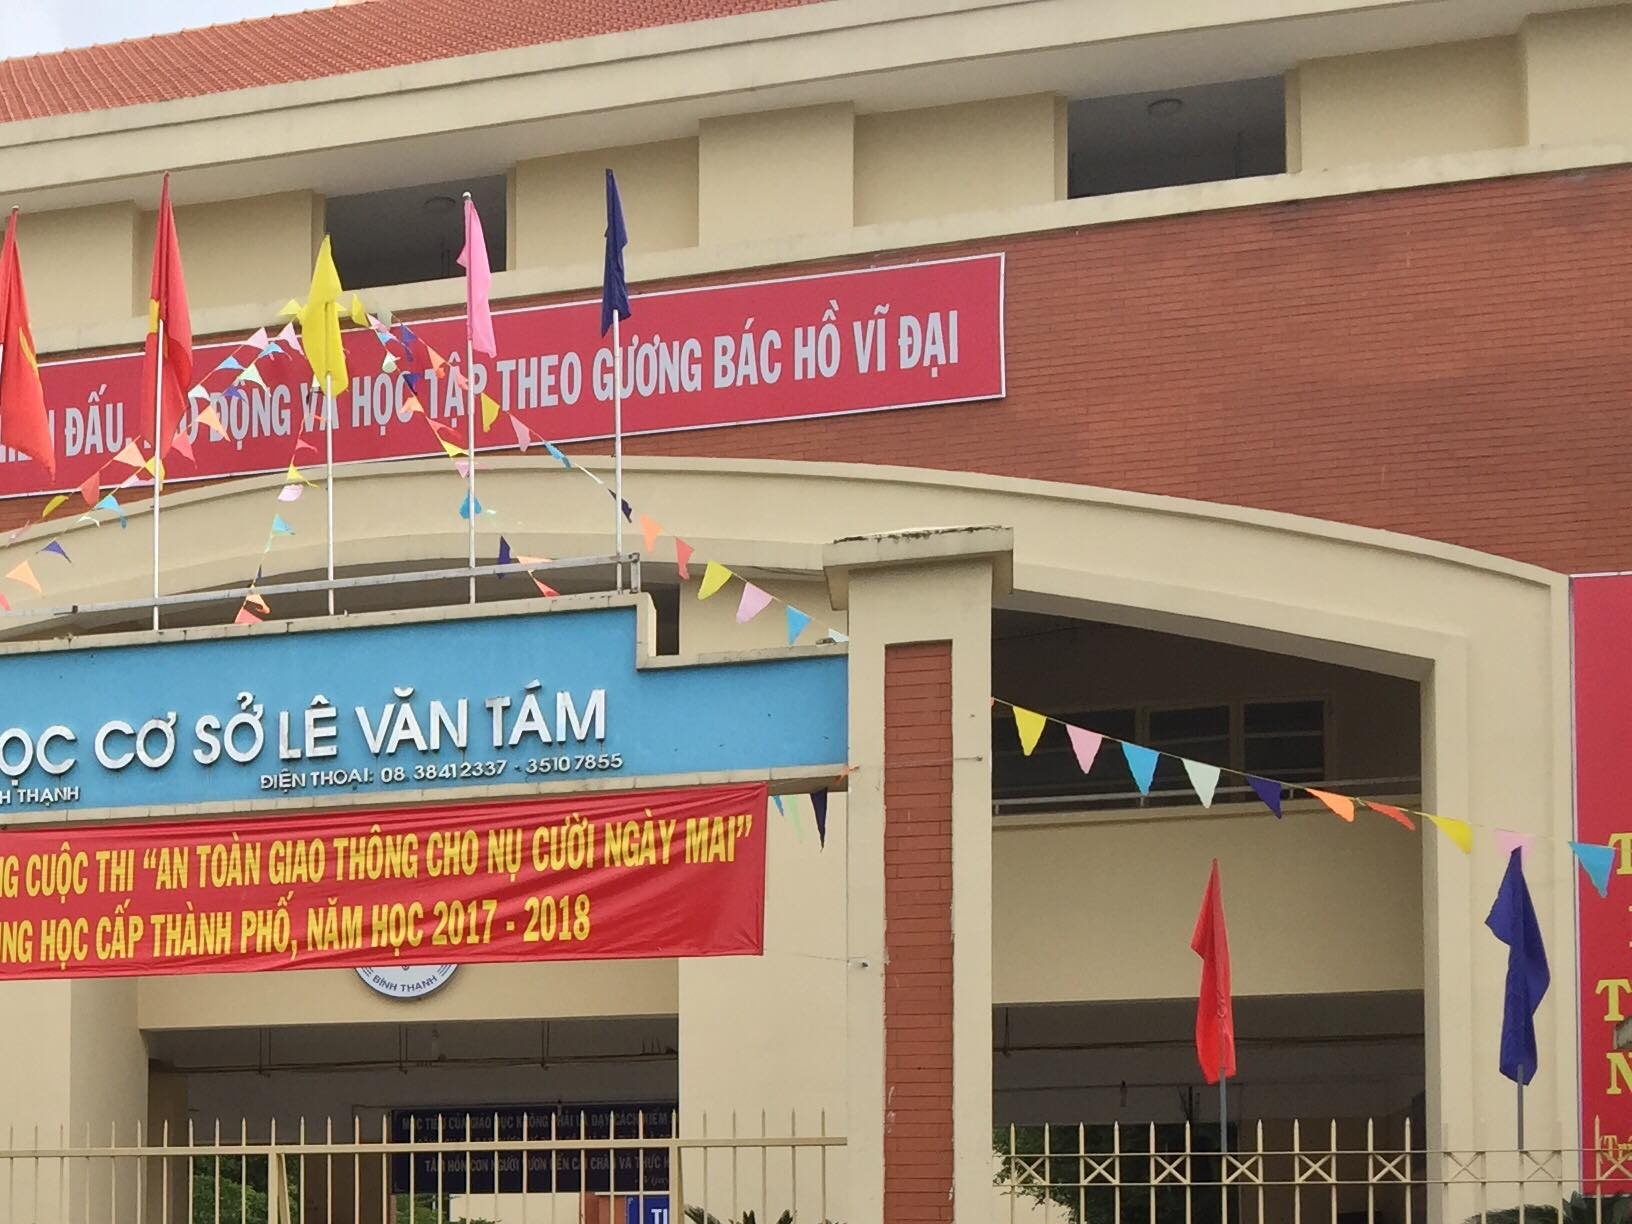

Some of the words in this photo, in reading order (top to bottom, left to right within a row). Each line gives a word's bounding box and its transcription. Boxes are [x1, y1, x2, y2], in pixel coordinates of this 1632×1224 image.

[496, 350, 583, 411] THEO
[592, 334, 703, 401] GƯƠNG
[713, 317, 783, 390] BÁC
[794, 299, 841, 380] HỒ
[852, 303, 890, 374] VĨ
[898, 310, 959, 378] ĐẠI
[94, 712, 177, 770] CƠ
[192, 690, 264, 764] SỞ
[279, 694, 338, 760] LÊ
[355, 686, 468, 755] VĂN
[485, 678, 607, 748] TÁM
[18, 785, 80, 807] THẠNH
[260, 768, 306, 793] ĐIỆN
[414, 759, 508, 781] 38412337
[26, 841, 89, 904] CUỘC
[96, 849, 135, 893] THI
[196, 832, 262, 888] TOÀN
[268, 838, 326, 885] GIAO
[333, 823, 419, 882] THÔNG
[426, 829, 479, 877] CHO
[487, 828, 523, 883] NỤ
[532, 812, 595, 872] CƯỜI
[604, 808, 677, 868] NGÀY
[40, 917, 89, 971] HỌC
[96, 899, 144, 960] CẤP
[150, 901, 232, 958] THÀNH
[241, 890, 298, 961] PHỐ,
[307, 897, 364, 952] NĂM
[371, 901, 424, 957] HỌC
[432, 898, 497, 946] 2017
[523, 894, 591, 942] 2018
